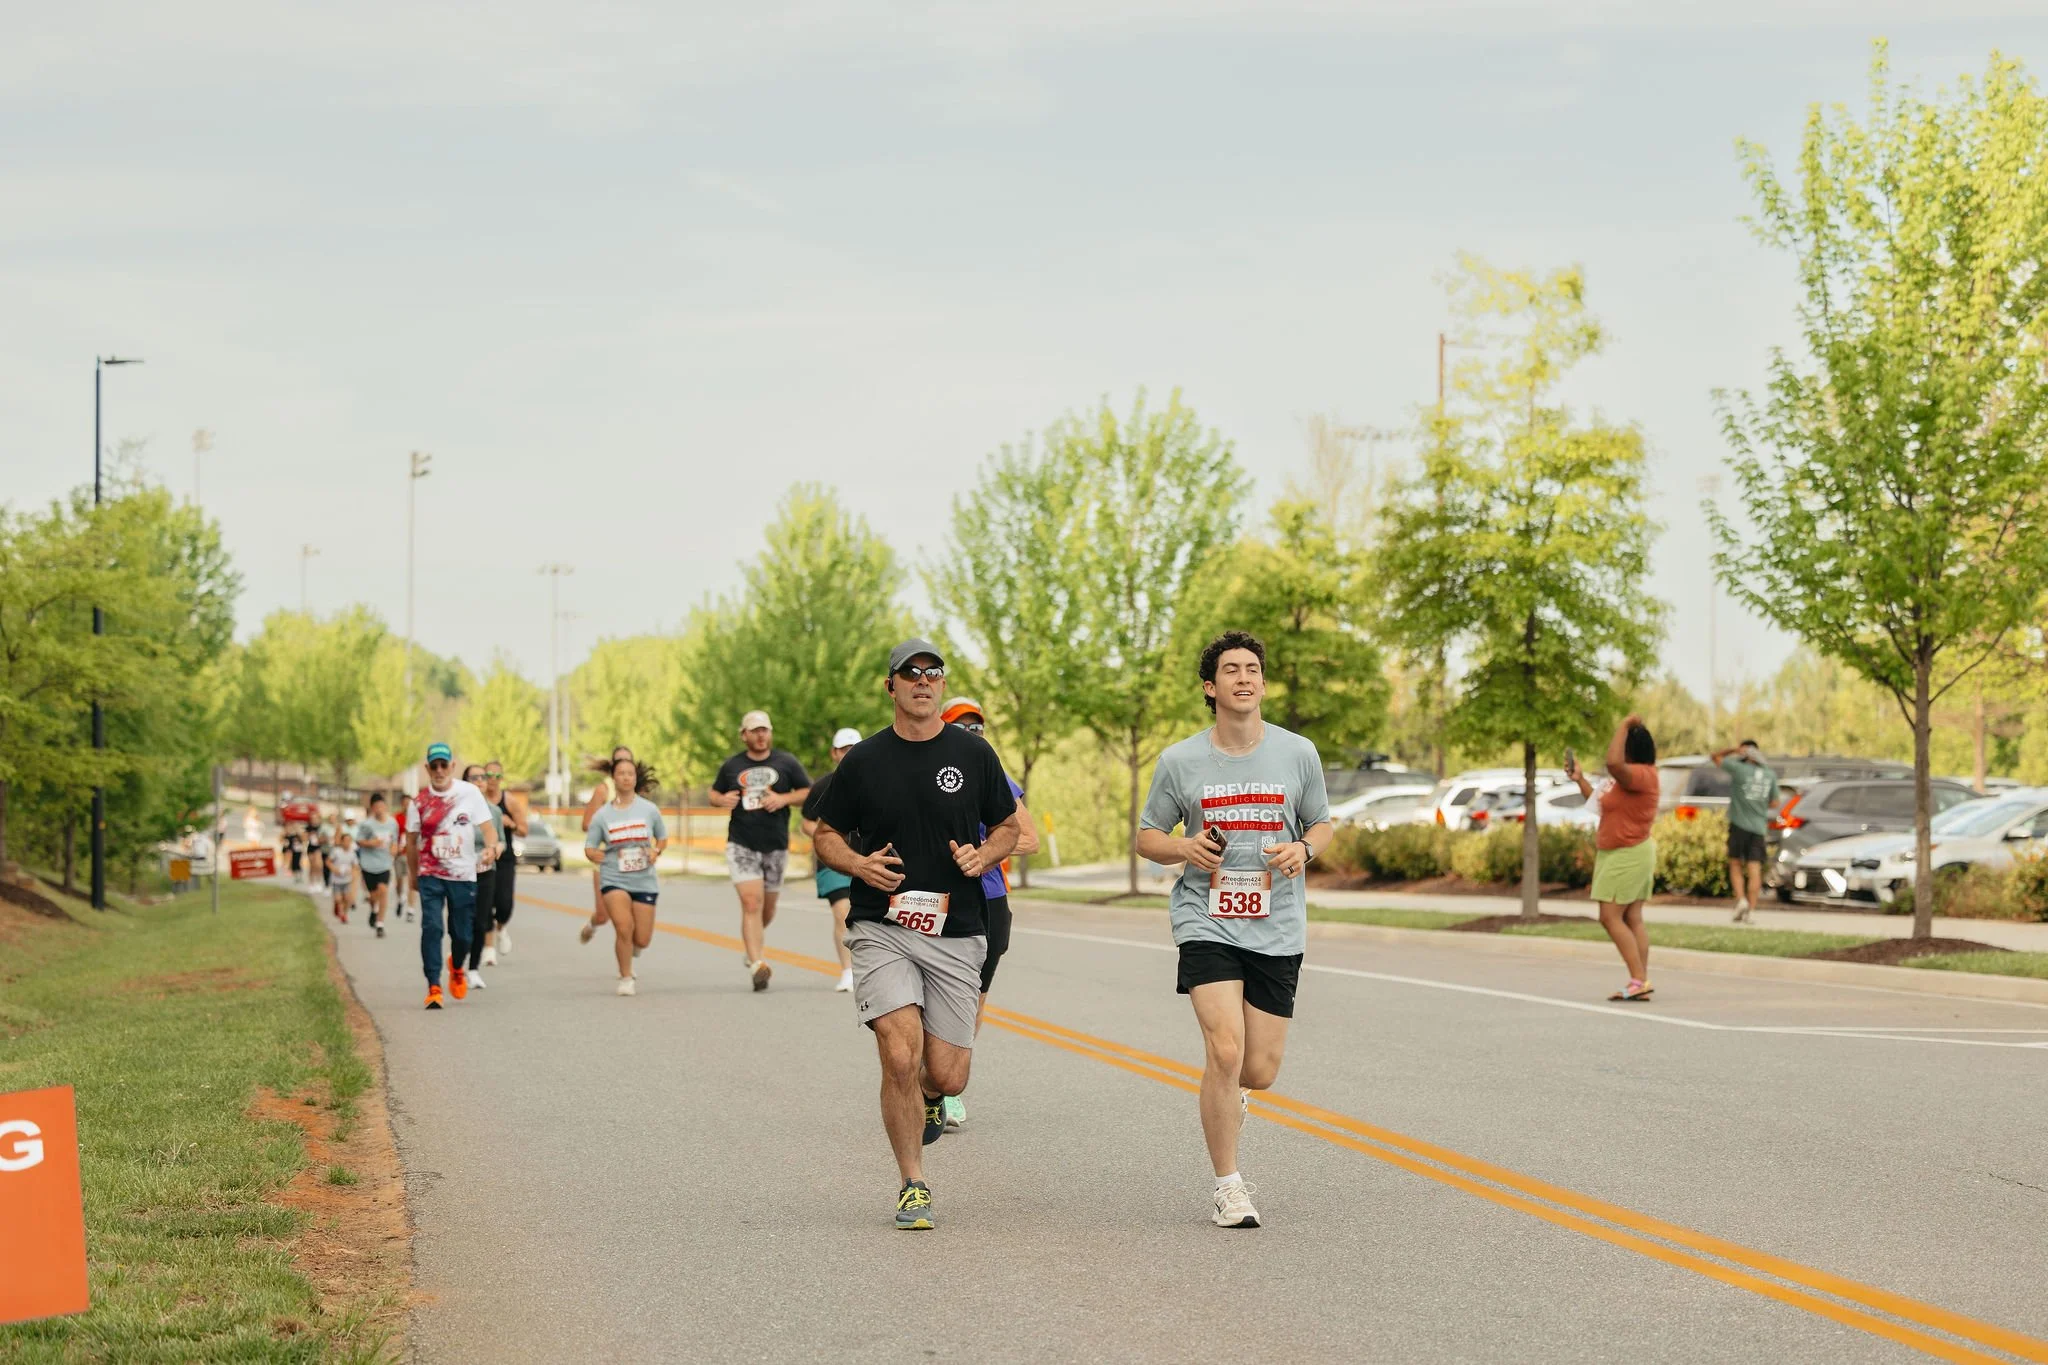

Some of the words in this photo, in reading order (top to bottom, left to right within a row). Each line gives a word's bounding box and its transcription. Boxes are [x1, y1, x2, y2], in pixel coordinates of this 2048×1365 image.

[1203, 782, 1285, 799] PREVENT
[1209, 794, 1277, 806] Trafficking
[1204, 808, 1283, 823] PROTECT
[1226, 821, 1282, 830] Vulnerable
[1218, 891, 1262, 914] 538
[896, 910, 937, 932] 565
[0, 1120, 44, 1171] G
